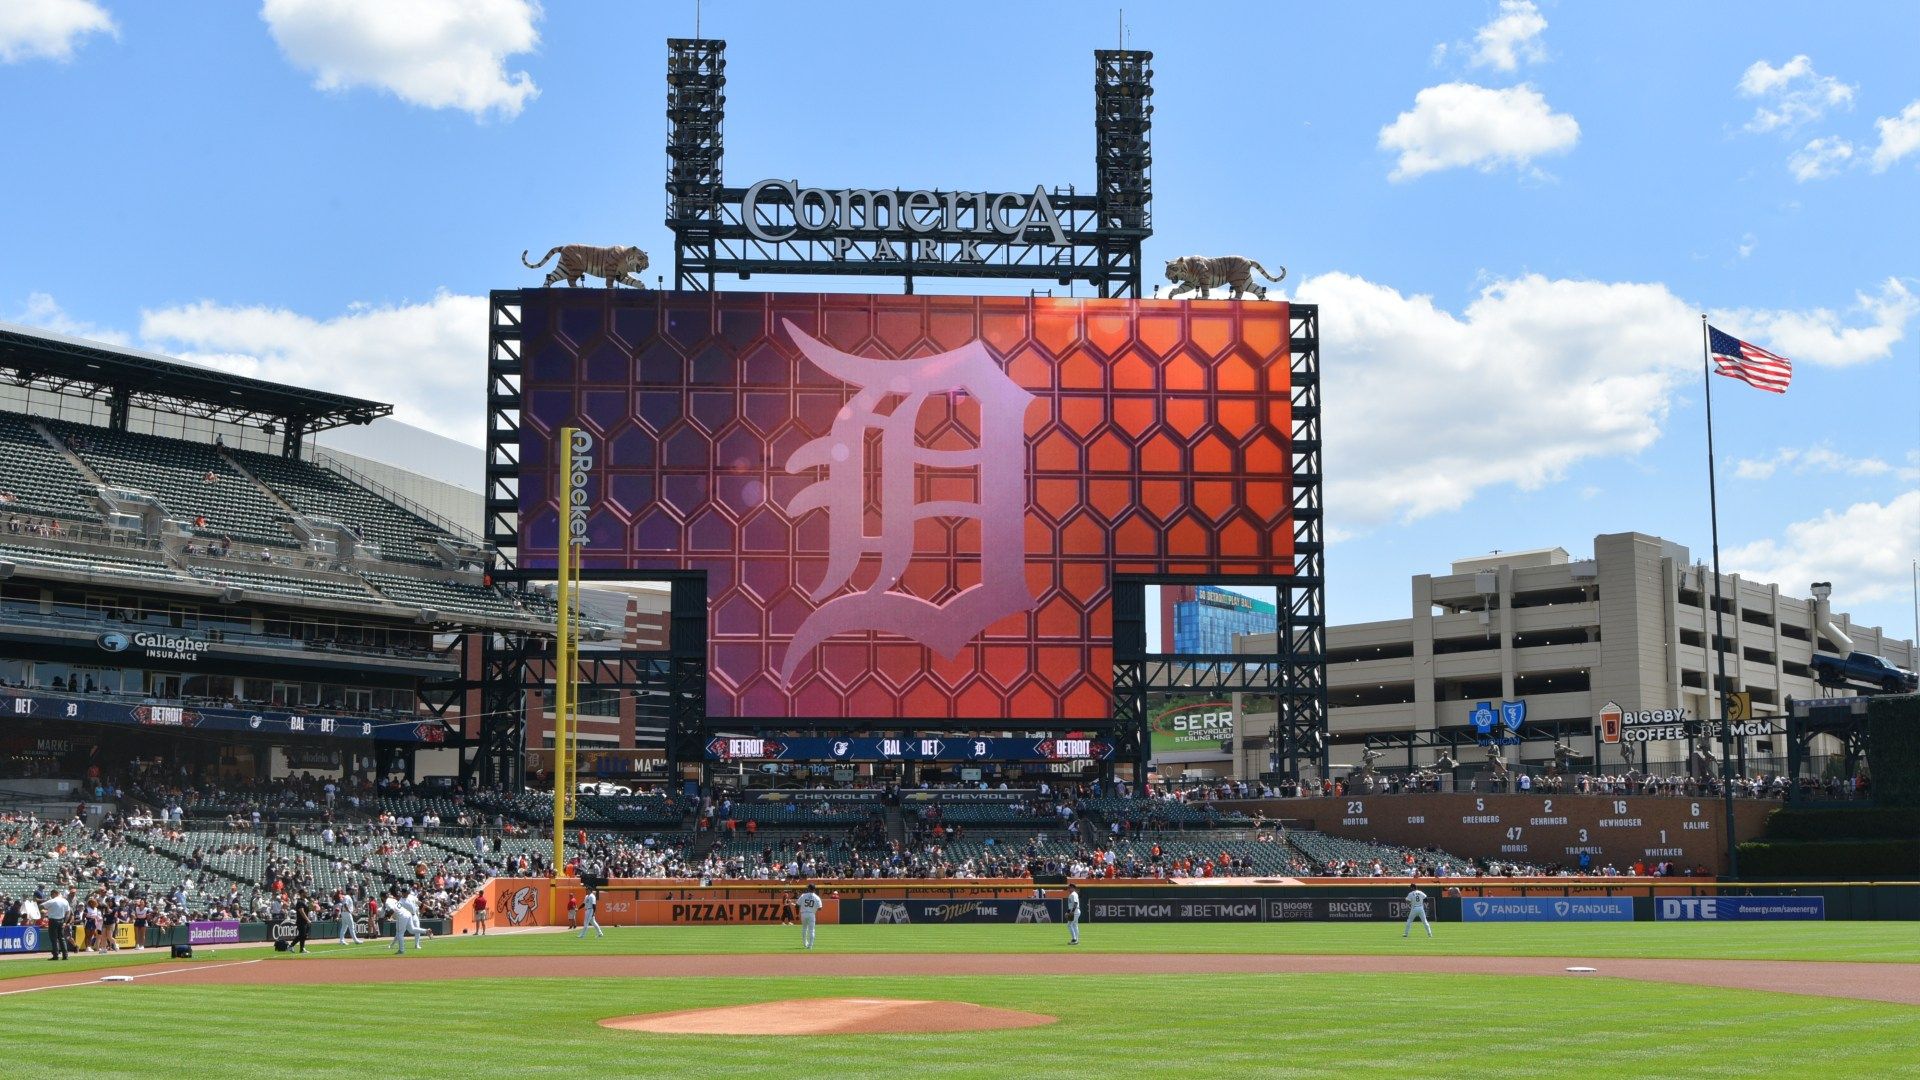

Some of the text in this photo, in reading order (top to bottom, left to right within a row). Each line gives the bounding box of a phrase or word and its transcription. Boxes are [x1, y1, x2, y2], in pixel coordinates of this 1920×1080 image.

[833, 236, 983, 263] PARK
[569, 455, 593, 546] Rocket
[134, 632, 210, 652] Gallagher
[146, 650, 198, 660] INSURANCE
[15, 698, 33, 714] DET
[151, 706, 184, 723] DETROIT
[1174, 711, 1234, 731] SERR
[290, 716, 305, 731] BAL
[320, 718, 335, 732] DET
[1701, 722, 1772, 737] BEMGM
[1188, 727, 1233, 736] CHEVROLET
[1624, 727, 1684, 741] COFFEE
[1174, 735, 1211, 743] STERLING
[730, 739, 765, 754] DETROIT
[883, 739, 901, 755] BAL
[921, 739, 938, 755] DET
[1056, 739, 1091, 755] DETROIT
[1347, 801, 1363, 814] 23
[1476, 798, 1485, 811] 5
[1544, 800, 1552, 813] 2
[1613, 800, 1627, 814] 16
[1691, 802, 1700, 816] 6
[1407, 816, 1425, 824] COBB
[1462, 815, 1500, 824] GREENBERG
[1530, 817, 1568, 825] GEHRINGER
[1599, 818, 1642, 827] NEWHOUSER
[1683, 821, 1710, 830] KALINE
[1506, 827, 1522, 840] 47
[1579, 828, 1588, 842] 3
[1659, 829, 1666, 843] 1
[1501, 844, 1528, 852] MORRIS
[1645, 848, 1683, 857] WHITAKER
[804, 899, 815, 908] 50
[1283, 902, 1313, 910] BIGGBY
[1328, 902, 1373, 912] BIGGBY
[1491, 905, 1542, 914] FANDUEL
[1572, 905, 1622, 914] FANDUEL
[1662, 899, 1718, 919] DTE
[1739, 904, 1818, 915] dteenergy.com/saveenergy
[672, 904, 800, 922] PIZZA! PIZZ!
[924, 901, 998, 922] IT'S Miller TIME
[1108, 905, 1172, 917] BETMGM
[1193, 904, 1257, 917] BETMGM
[190, 926, 238, 942] planet fitness
[4, 937, 13, 949] OIL
